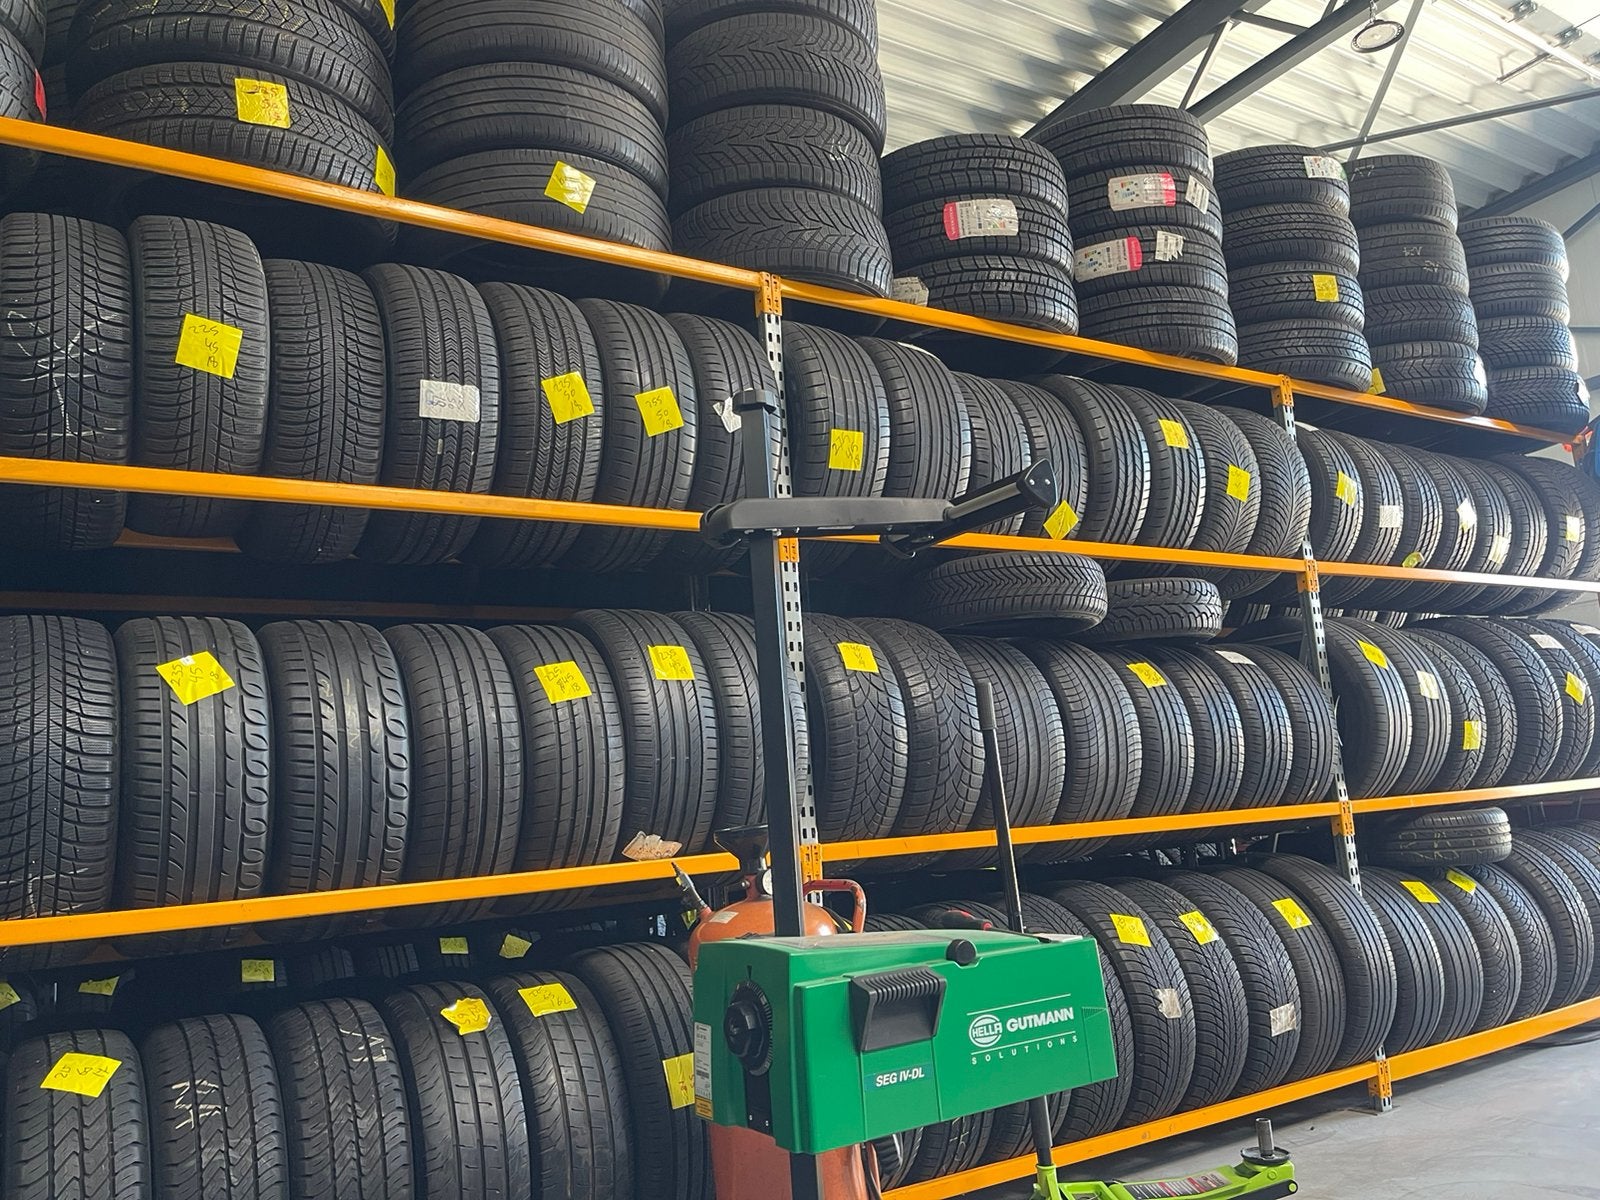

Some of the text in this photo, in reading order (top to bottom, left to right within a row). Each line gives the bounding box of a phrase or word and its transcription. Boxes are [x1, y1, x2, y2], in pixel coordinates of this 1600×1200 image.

[188, 324, 219, 336] 225
[972, 1007, 1075, 1038] HELLA GUTMANN
[971, 1034, 1078, 1066] SOLUTIONS
[875, 1067, 926, 1088] SEG IV-DL
